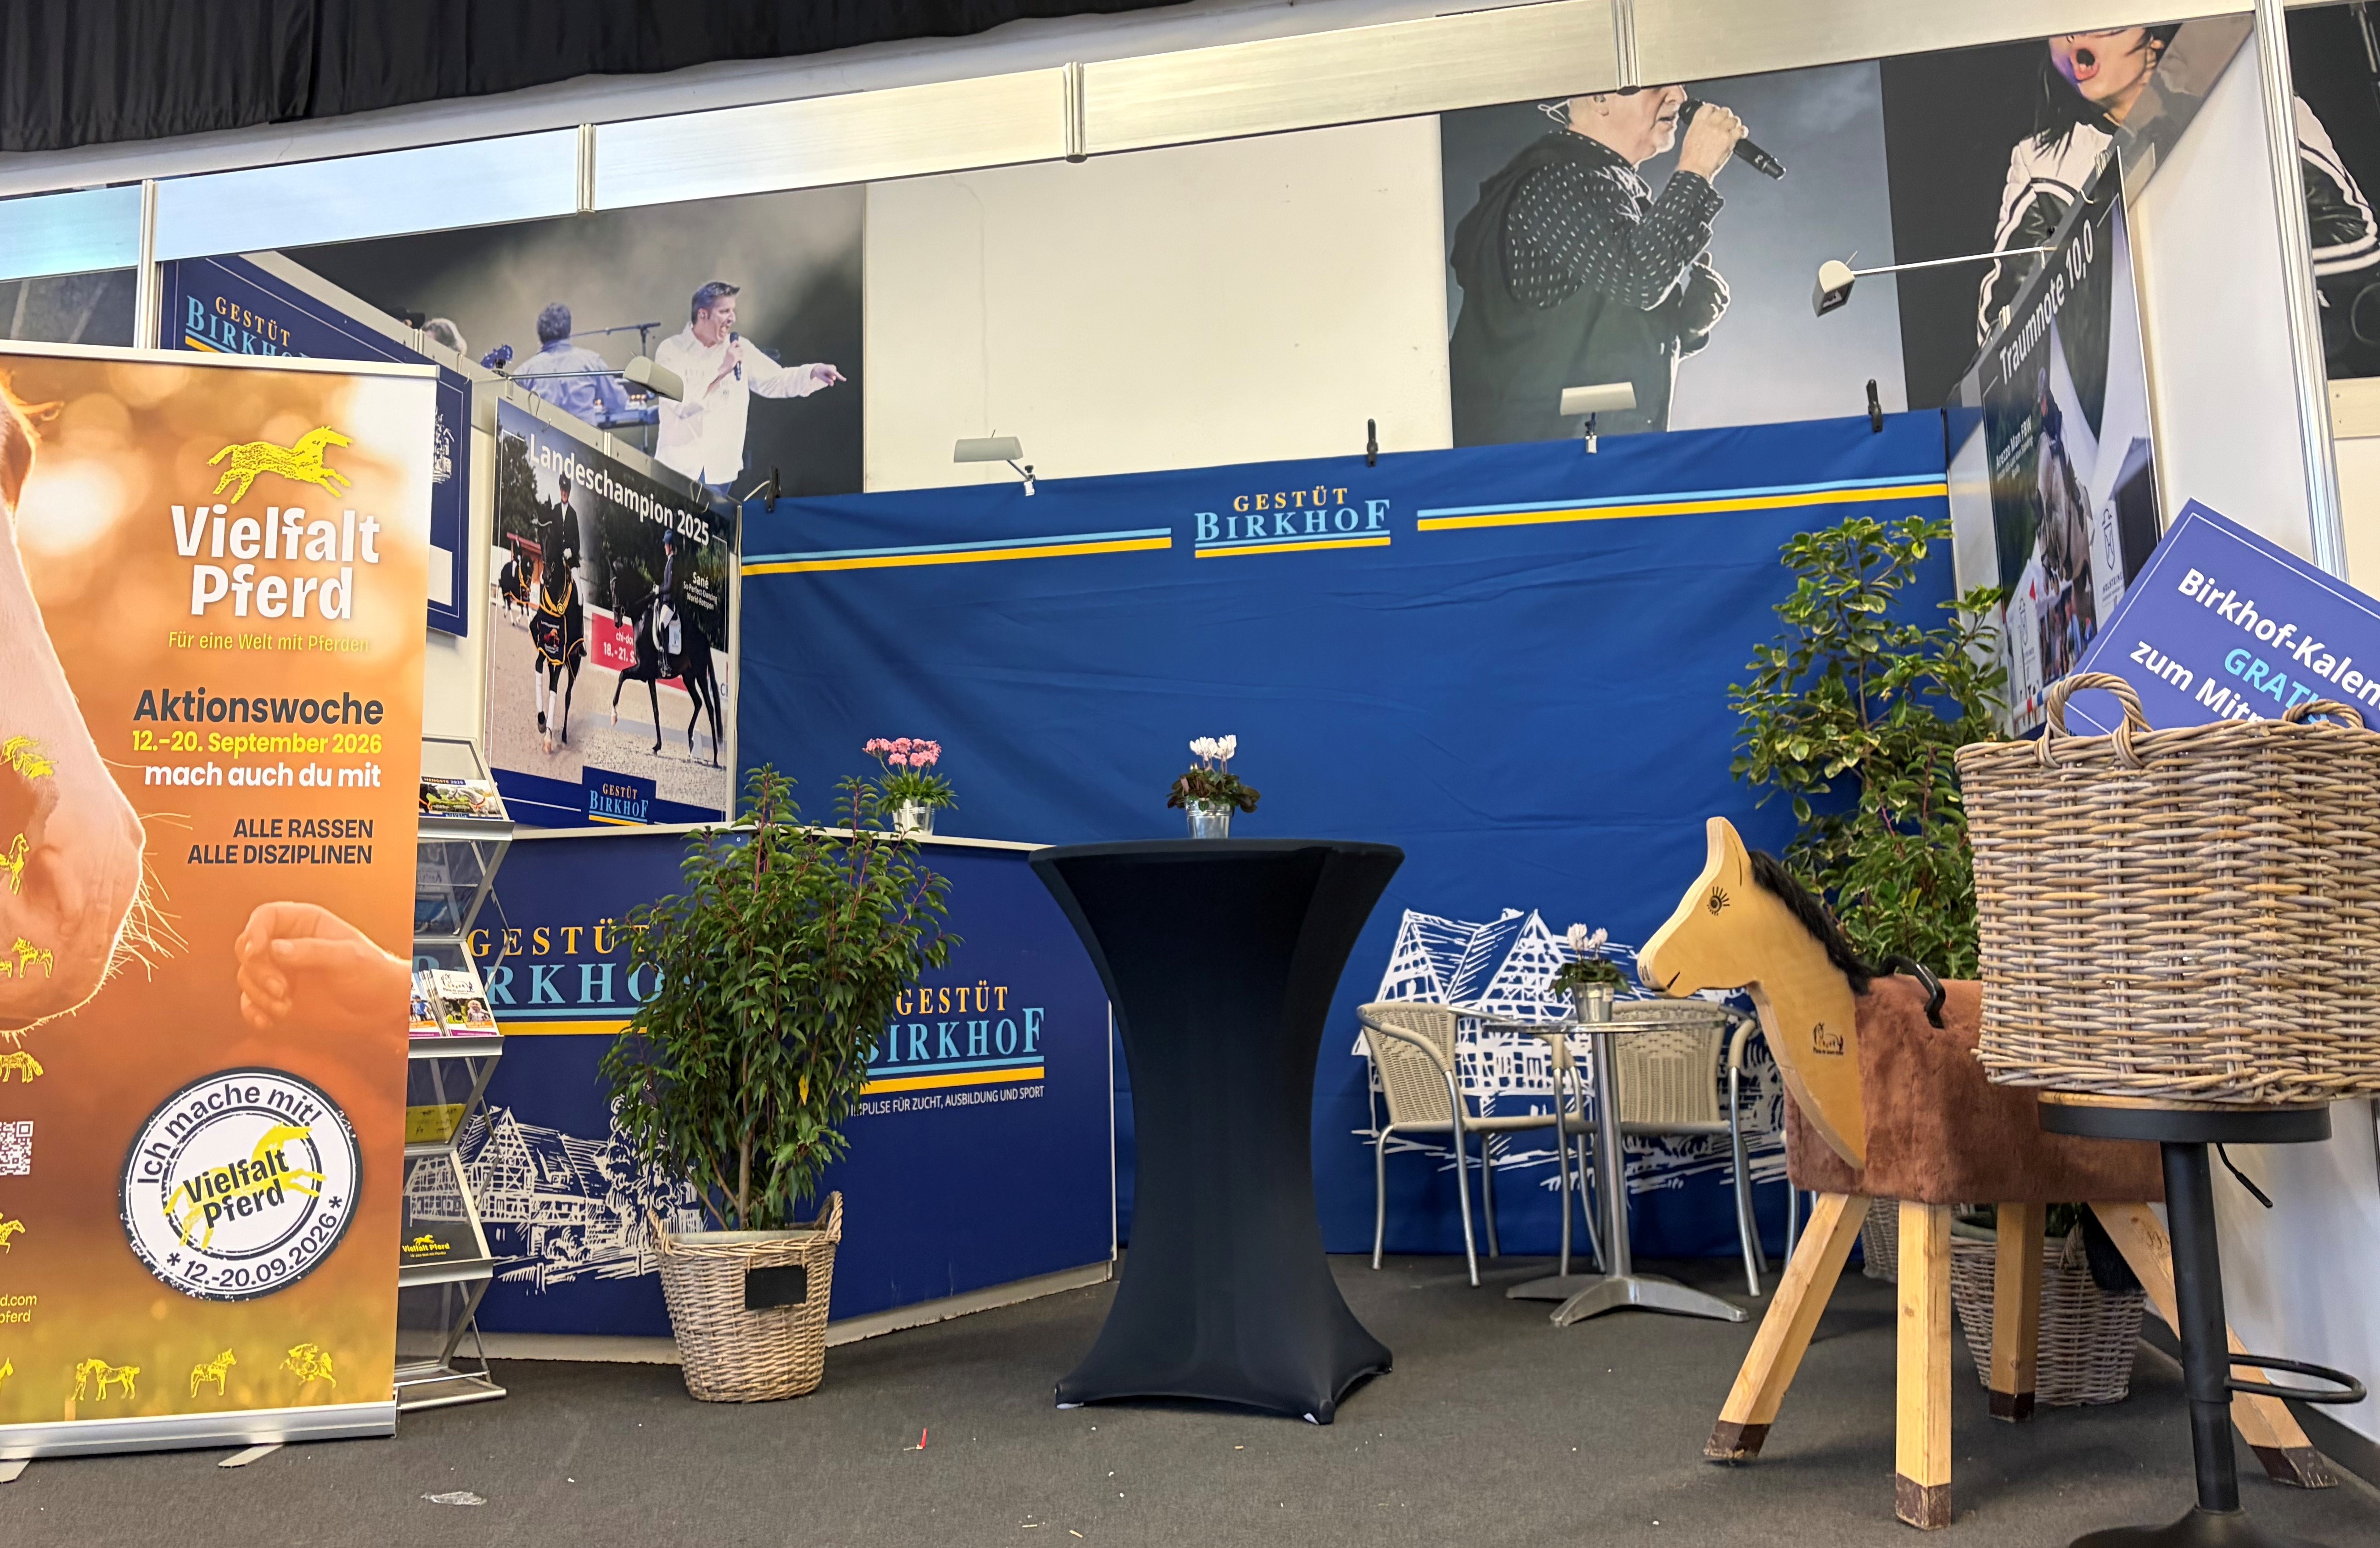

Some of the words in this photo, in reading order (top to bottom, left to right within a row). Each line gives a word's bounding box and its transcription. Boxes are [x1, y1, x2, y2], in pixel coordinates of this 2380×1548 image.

[215, 296, 291, 347] GESTÜT
[1999, 273, 2065, 384] Traumnote
[2066, 219, 2093, 289] 10,0
[185, 295, 310, 358] BIRKH
[530, 434, 673, 529] Landeschampion
[677, 509, 709, 545] 2025
[1234, 485, 1347, 512] GESTÜT
[171, 504, 380, 563] Vielfalt
[1195, 499, 1390, 541] BIRKHOF
[191, 564, 353, 619] Pferd
[693, 572, 708, 589] Sané
[169, 631, 194, 648] Für
[199, 632, 233, 649] eine
[238, 633, 272, 650] Welt
[278, 634, 303, 651] mit
[309, 634, 369, 652] Pferden
[616, 631, 634, 645] chi-do
[2178, 568, 2380, 711] Birkhof-Kalen
[2130, 641, 2193, 691] zum
[2225, 648, 2327, 724] GRAT
[133, 687, 384, 725] Aktionswoche
[208, 732, 328, 759] September
[332, 733, 382, 754] 2026
[145, 761, 223, 786] mach
[228, 762, 293, 787] auch
[298, 763, 332, 787] du
[338, 762, 381, 787] mit
[603, 783, 638, 800] GESTÜT
[589, 790, 649, 818] BIRKHOF
[233, 819, 283, 838] ALLE
[288, 819, 373, 839] RASSEN
[187, 844, 238, 864] ALLE
[243, 845, 372, 864] DISZIPLINEN
[896, 980, 1008, 1015] GESTÜT
[893, 1097, 910, 1112] FÜR
[912, 1095, 943, 1111] ZUCHT,
[945, 1090, 998, 1106] AUSBILDUNG
[1000, 1088, 1018, 1101] UND
[1019, 1085, 1044, 1099] SPORT
[137, 1142, 172, 1184] Ich
[164, 1083, 260, 1139] mache
[267, 1088, 323, 1126] mit!
[183, 1149, 290, 1204] Vielfalt
[203, 1178, 285, 1228] Pferd
[184, 1213, 337, 1288] 12.-20.09.2026
[0, 1294, 37, 1307] d.com
